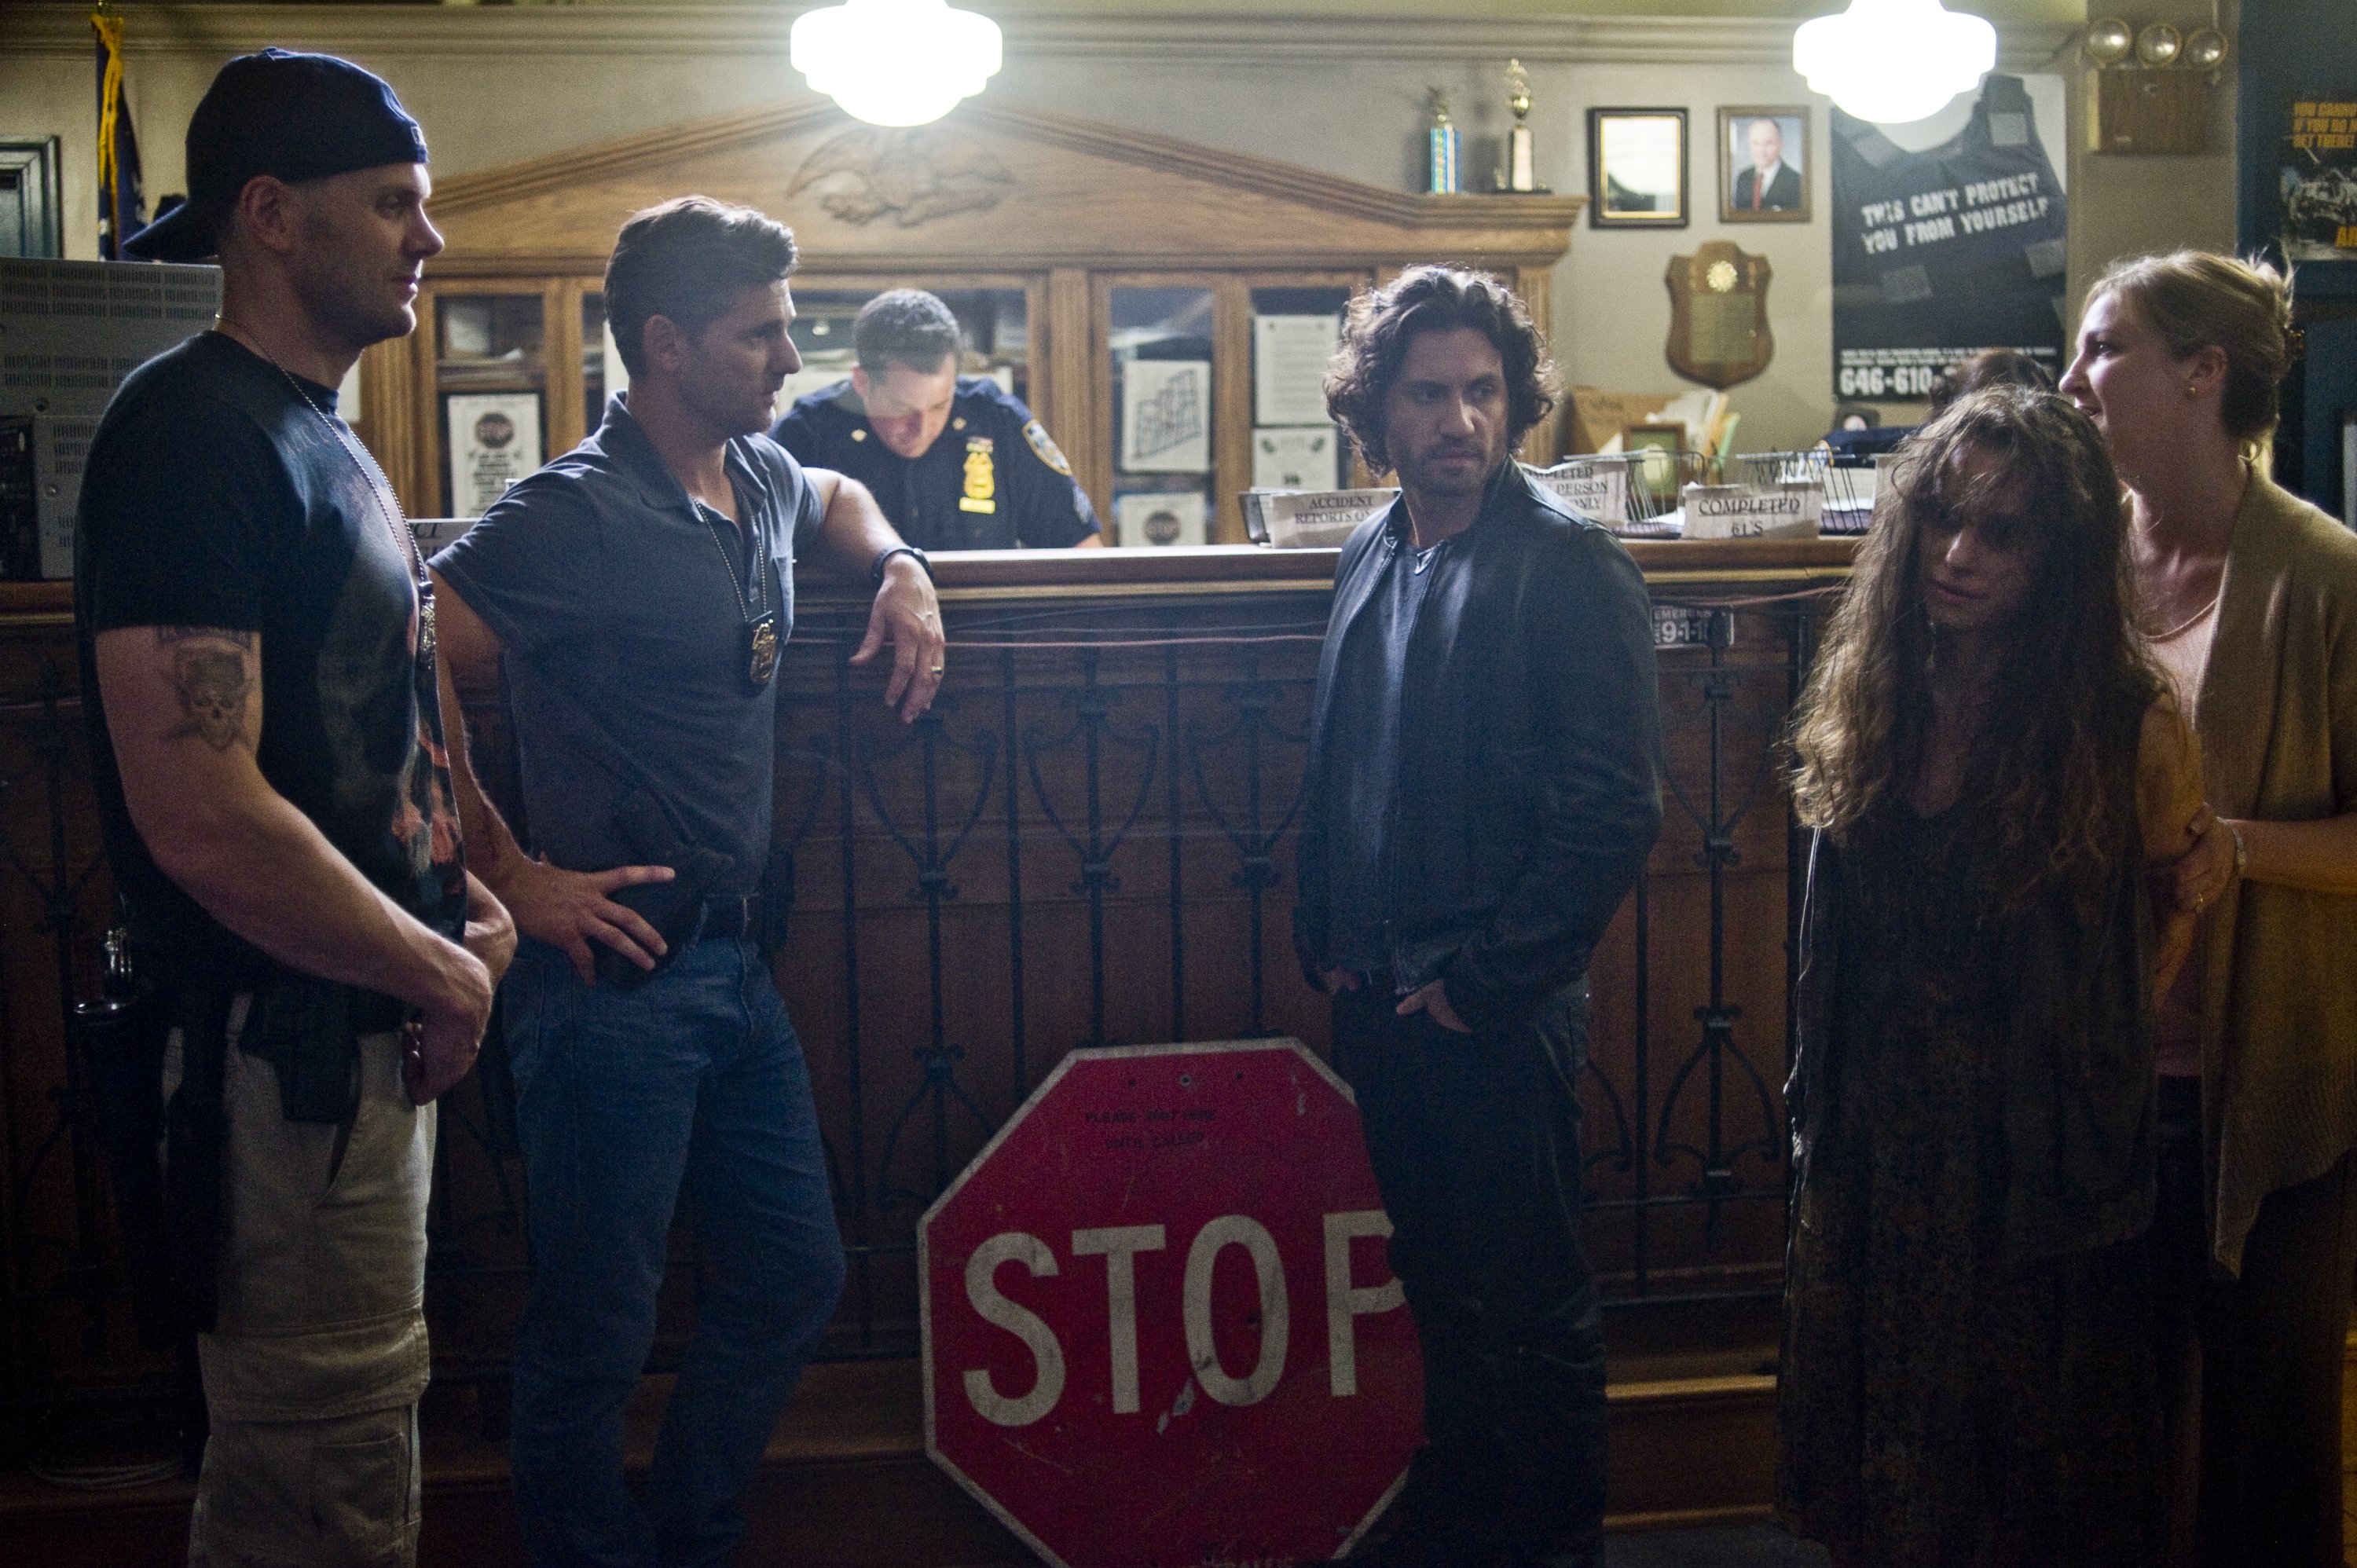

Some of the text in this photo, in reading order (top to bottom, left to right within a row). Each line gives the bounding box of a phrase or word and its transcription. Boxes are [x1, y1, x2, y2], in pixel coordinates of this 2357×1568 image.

[1861, 172, 2040, 227] THIS CAN'T PROTECT
[1861, 196, 2048, 255] YOU FROM YOURSELF
[1557, 480, 1608, 495] PERSON
[1309, 495, 1373, 510] ACCIDENT
[1699, 498, 1800, 515] COMPLETED
[1294, 511, 1351, 524] REPORTS
[963, 1210, 1405, 1427] STOP
